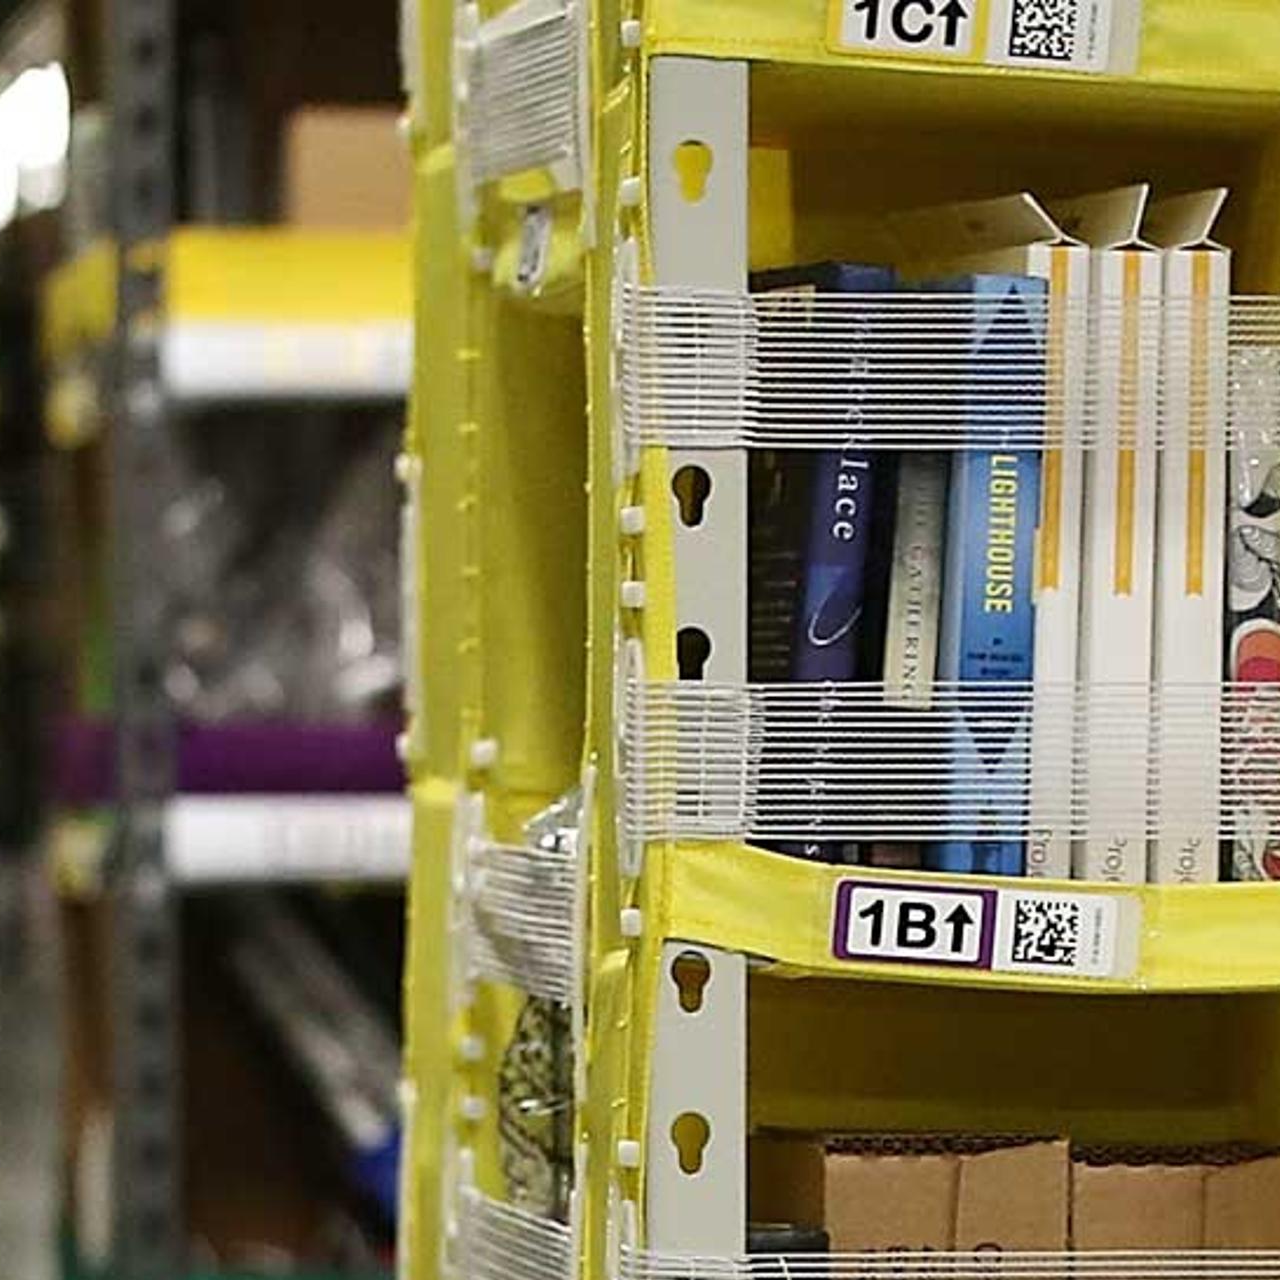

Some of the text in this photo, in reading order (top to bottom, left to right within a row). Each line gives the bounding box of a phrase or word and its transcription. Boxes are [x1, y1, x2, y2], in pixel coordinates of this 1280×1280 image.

[854, 0, 934, 44] 1C
[984, 455, 1018, 613] LIGHTHOUSE
[858, 899, 938, 949] 1B
